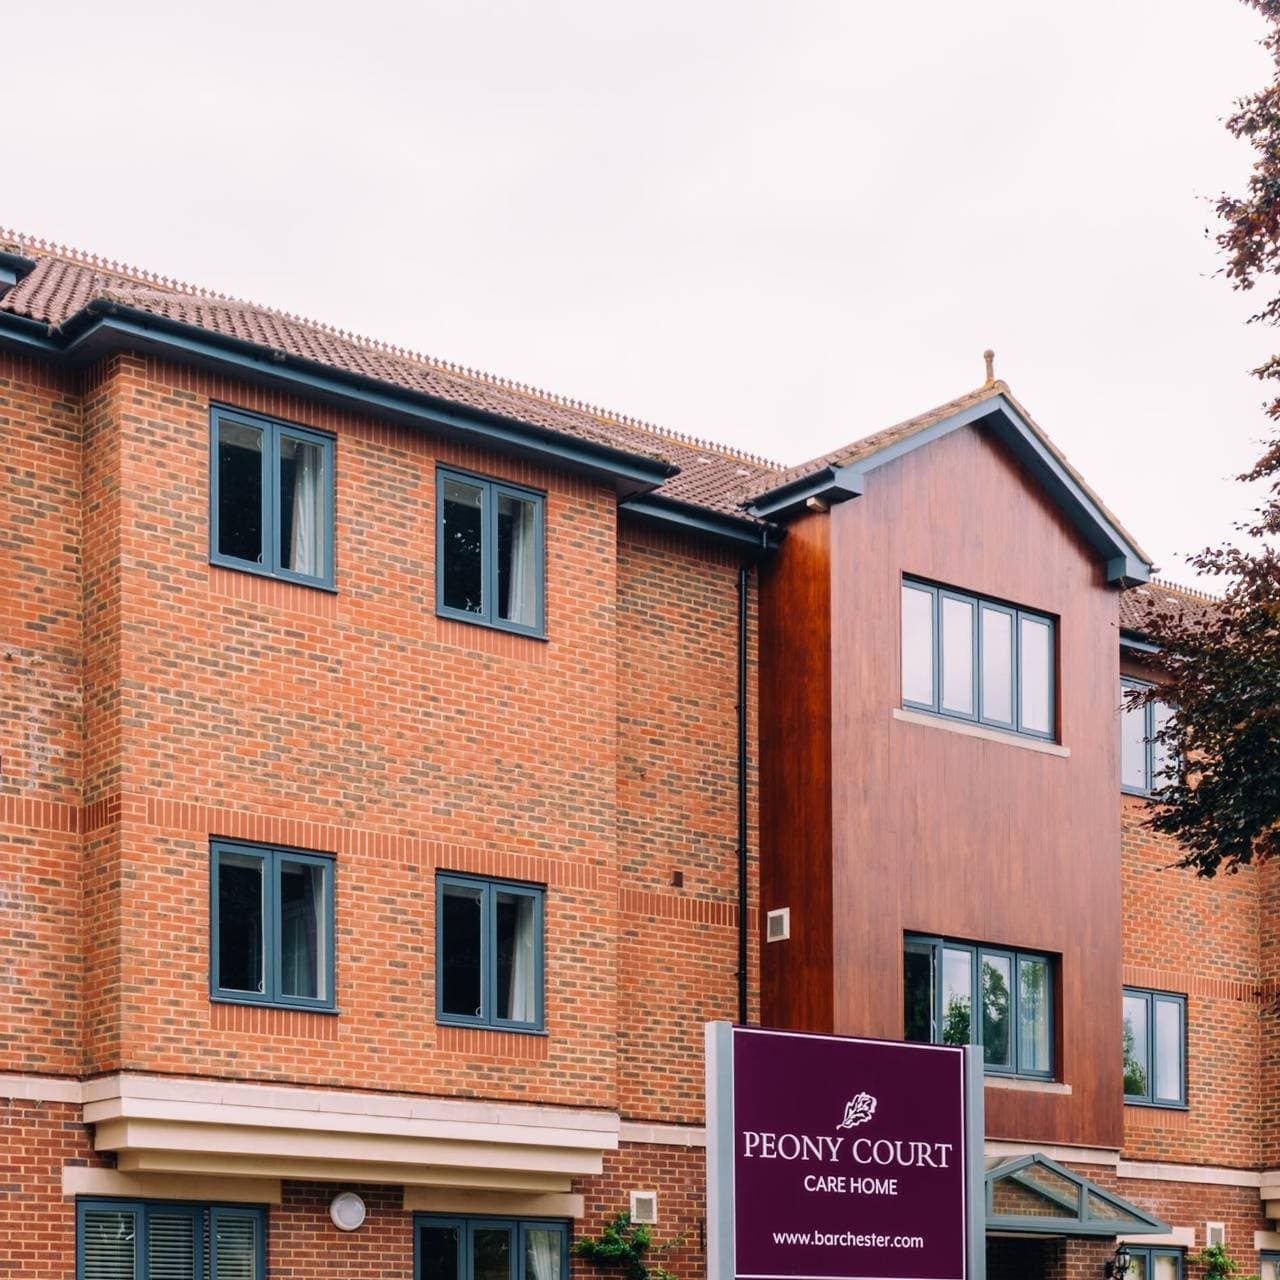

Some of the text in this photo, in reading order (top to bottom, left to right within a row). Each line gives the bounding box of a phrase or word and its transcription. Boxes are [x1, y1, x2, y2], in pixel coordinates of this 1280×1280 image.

[743, 1131, 953, 1168] PEONY COURT
[804, 1175, 898, 1195] CARE HOME
[773, 1230, 924, 1248] www.barchester.com
